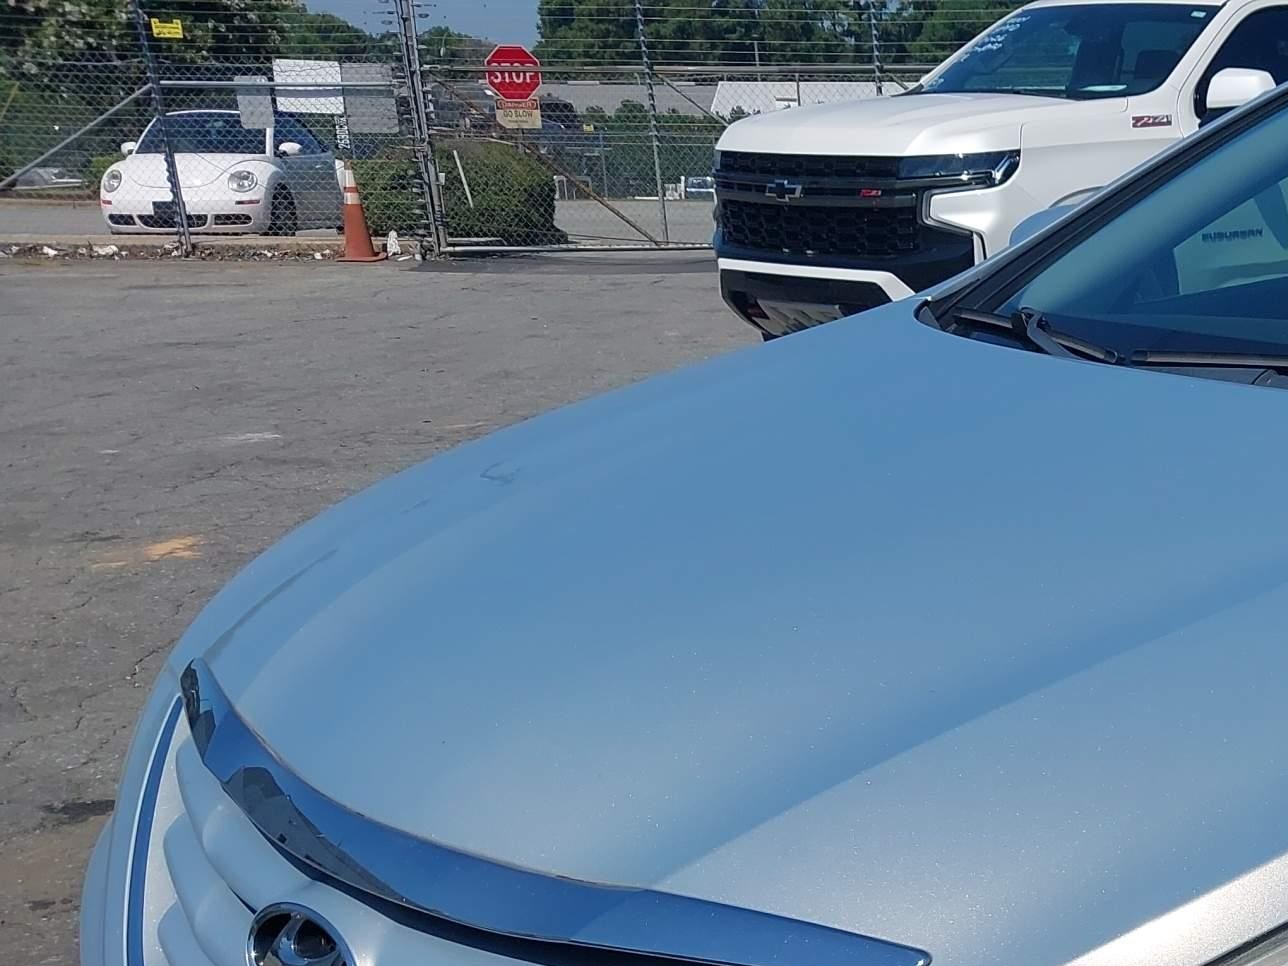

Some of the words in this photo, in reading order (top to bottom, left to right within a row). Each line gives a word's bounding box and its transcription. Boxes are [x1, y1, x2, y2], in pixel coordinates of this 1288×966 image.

[490, 63, 535, 83] STOP
[503, 110, 513, 118] GO
[514, 110, 533, 118] SLOW
